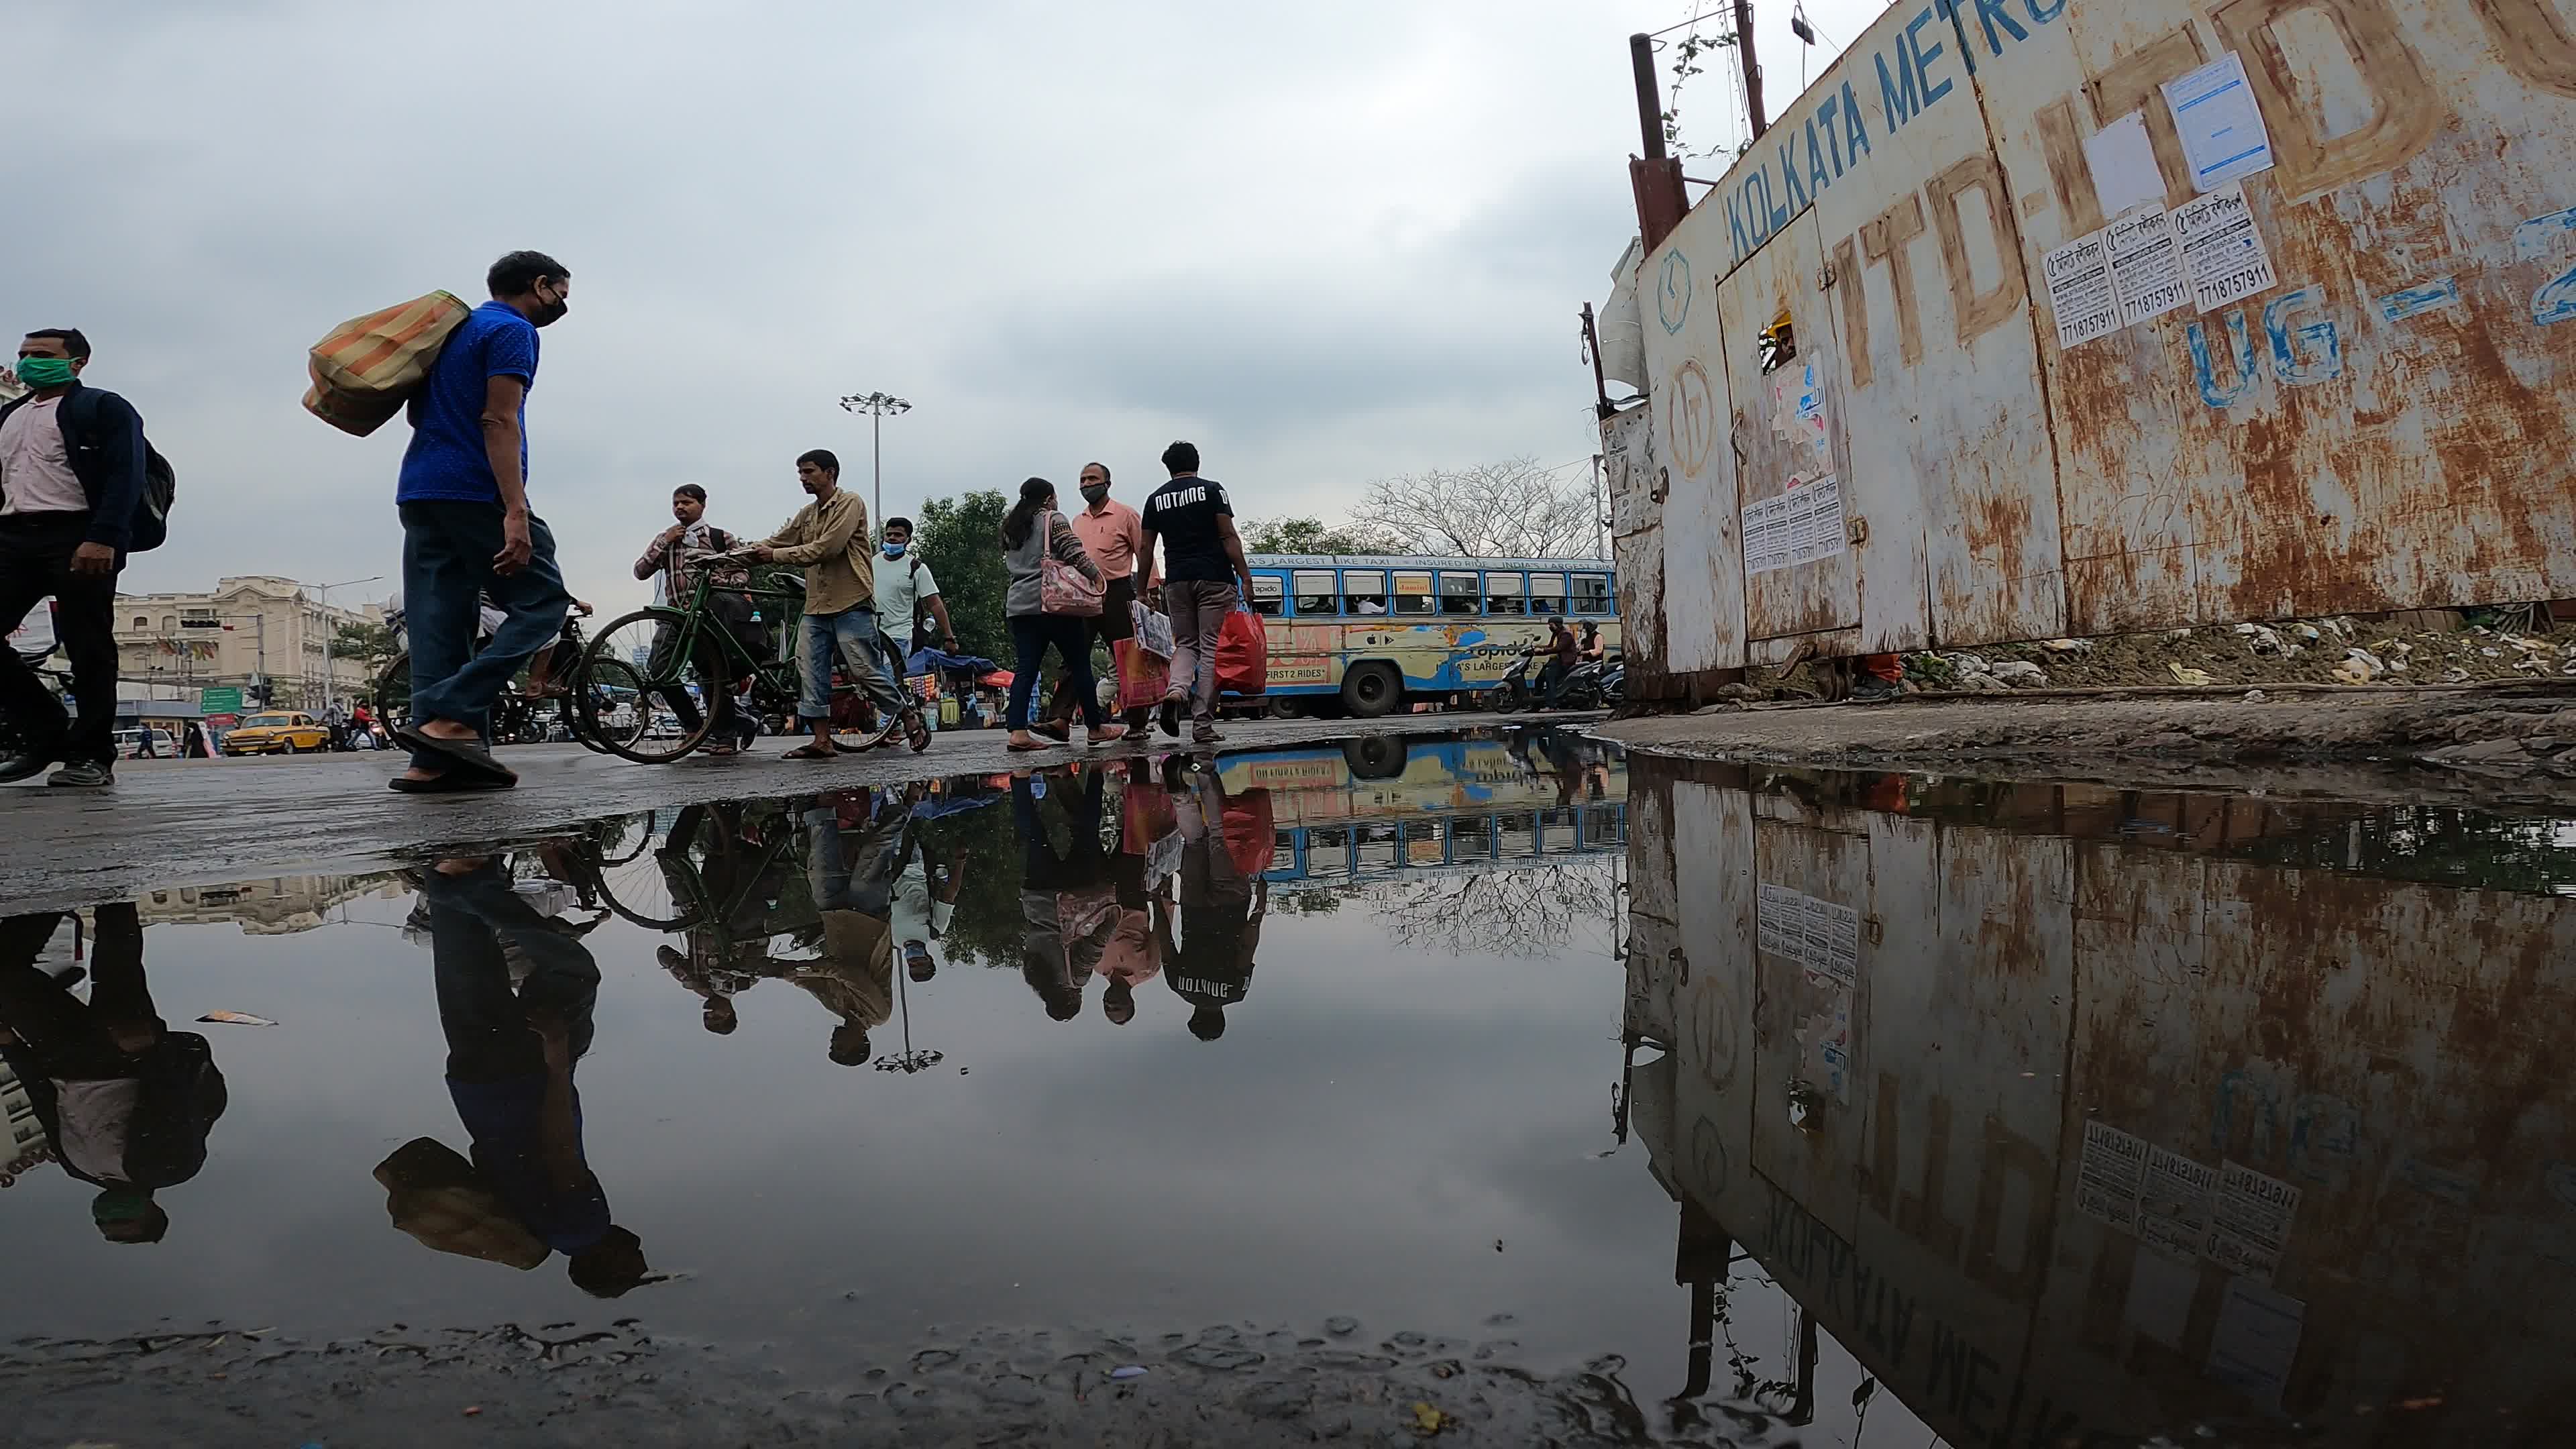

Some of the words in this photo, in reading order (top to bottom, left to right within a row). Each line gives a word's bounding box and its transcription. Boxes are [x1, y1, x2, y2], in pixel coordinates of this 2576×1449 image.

[1727, 80, 1872, 263] KOLKATA
[2198, 263, 2270, 307] 7718757911
[2125, 280, 2186, 320] 7718757911
[2061, 308, 2117, 343] 7718757911
[1155, 486, 1206, 513] NOTHING
[1271, 557, 1326, 566] LARGEST
[1415, 559, 1462, 567] INSURED
[1503, 561, 1540, 570] INDIA'S
[1470, 639, 1522, 660] rapid
[1267, 670, 1289, 679] FIRST
[1290, 670, 1295, 678] 2
[1473, 662, 1511, 672] LARGES
